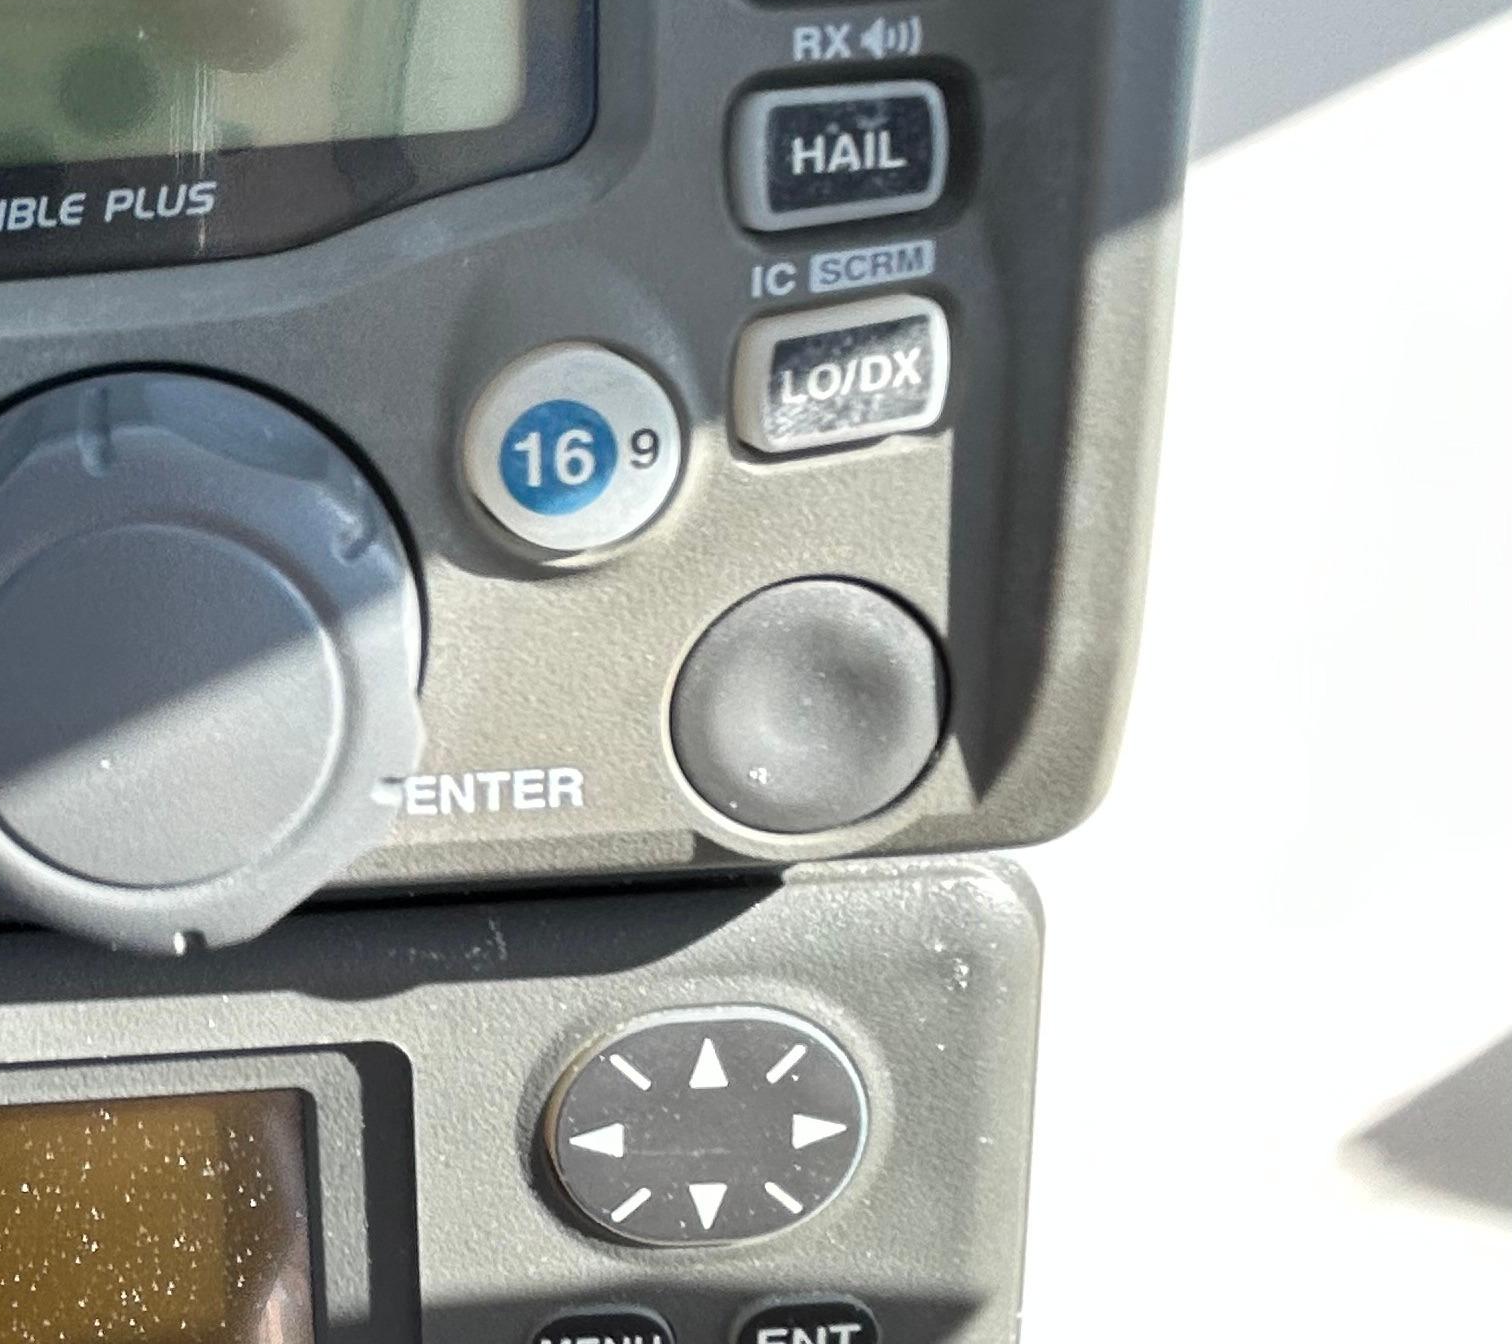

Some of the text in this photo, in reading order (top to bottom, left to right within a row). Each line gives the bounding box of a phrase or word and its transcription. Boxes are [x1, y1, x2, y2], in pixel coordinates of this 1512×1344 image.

[791, 22, 852, 62] RX
[788, 129, 909, 176] HAIL
[103, 180, 218, 224] PLUS
[750, 245, 926, 297] IC SCRM
[779, 345, 924, 407] LO/DX
[512, 427, 660, 489] 16 9
[405, 767, 586, 817] ENTER
